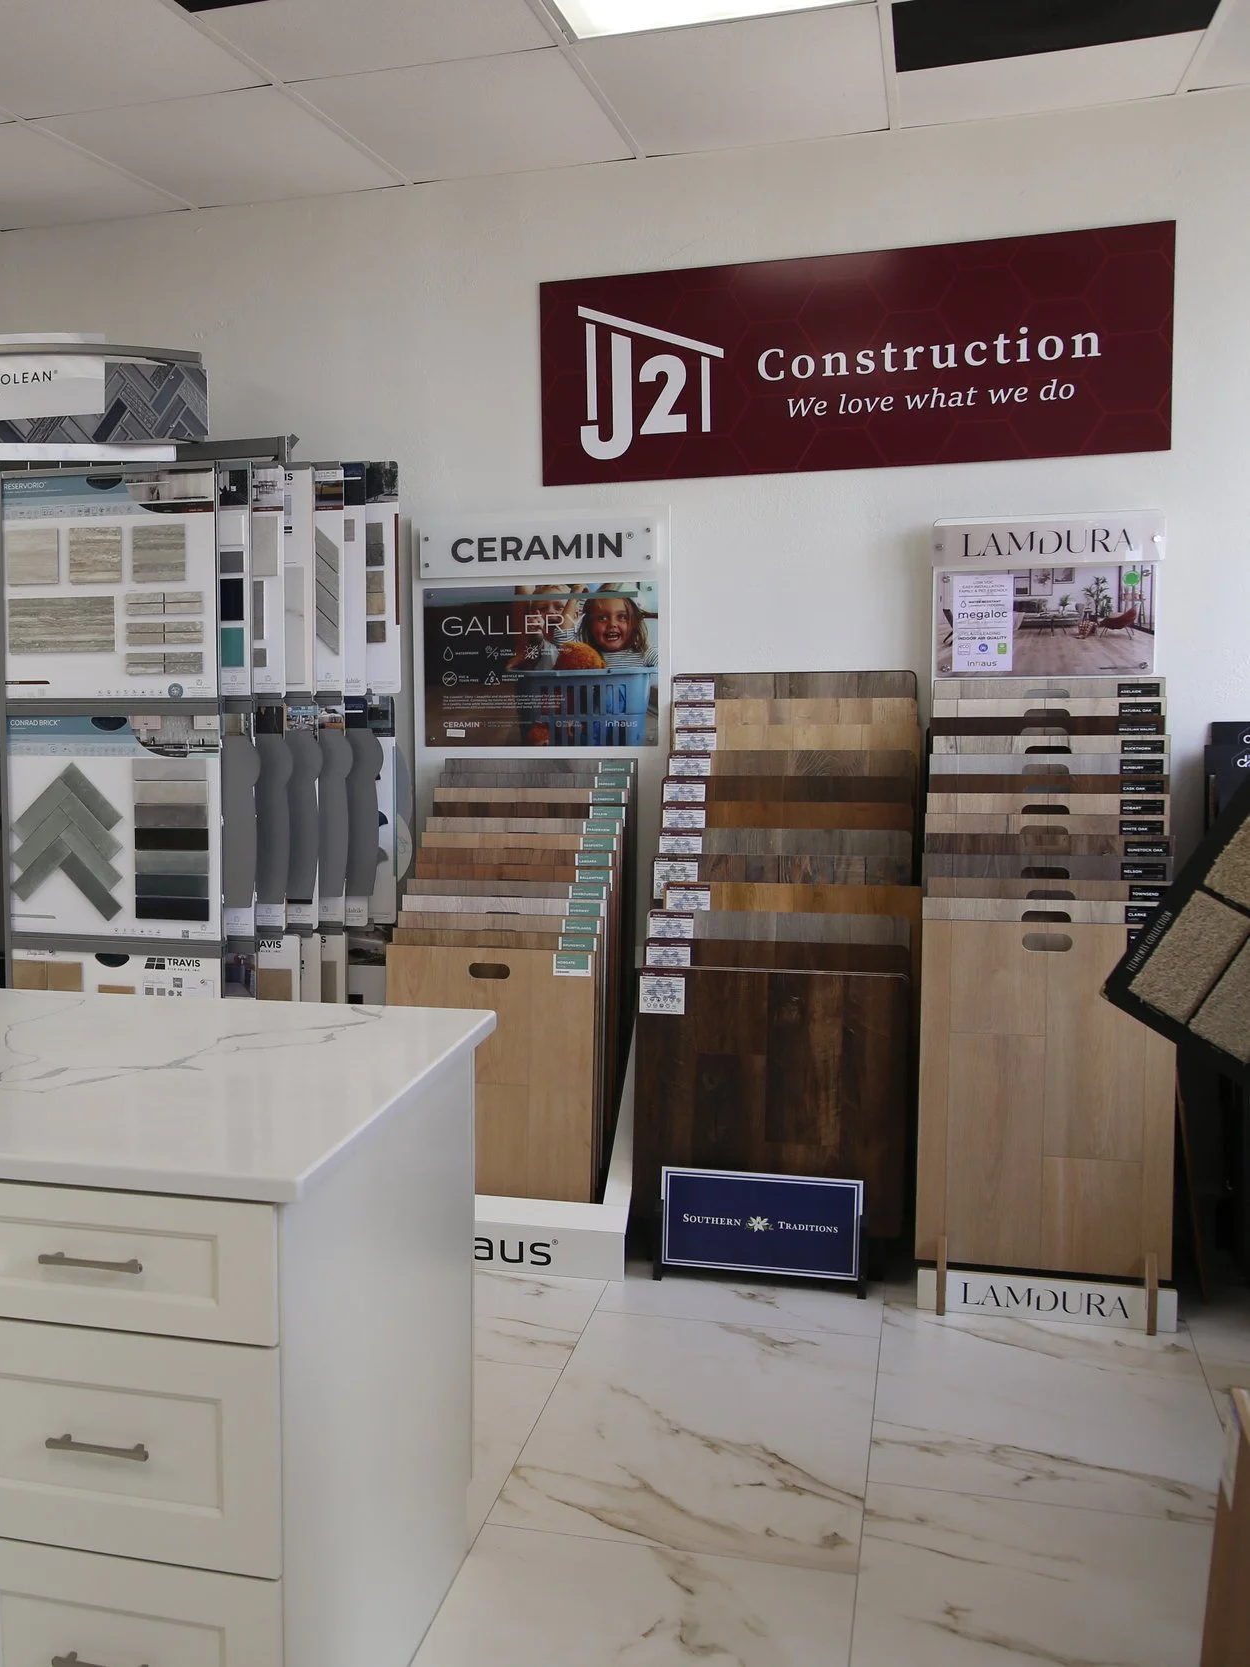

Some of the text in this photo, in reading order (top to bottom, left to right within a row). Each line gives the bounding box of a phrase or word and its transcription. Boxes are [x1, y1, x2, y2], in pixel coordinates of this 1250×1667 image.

[757, 326, 1103, 382] Construction
[0, 370, 53, 386] OLEAN
[580, 332, 688, 461] J2
[786, 379, 1076, 419] We love what we do
[961, 527, 1134, 558] LAMDURA
[441, 614, 586, 637] GALLERY
[958, 609, 1008, 621] megaloc
[10, 719, 38, 727] CONRAD
[259, 940, 282, 949] AVIS
[167, 957, 201, 968] TRAVIS
[682, 1212, 840, 1235] SOUTHERN TRADITIONS
[474, 1235, 559, 1267] aus®
[961, 1281, 1129, 1320] LAMDURA
